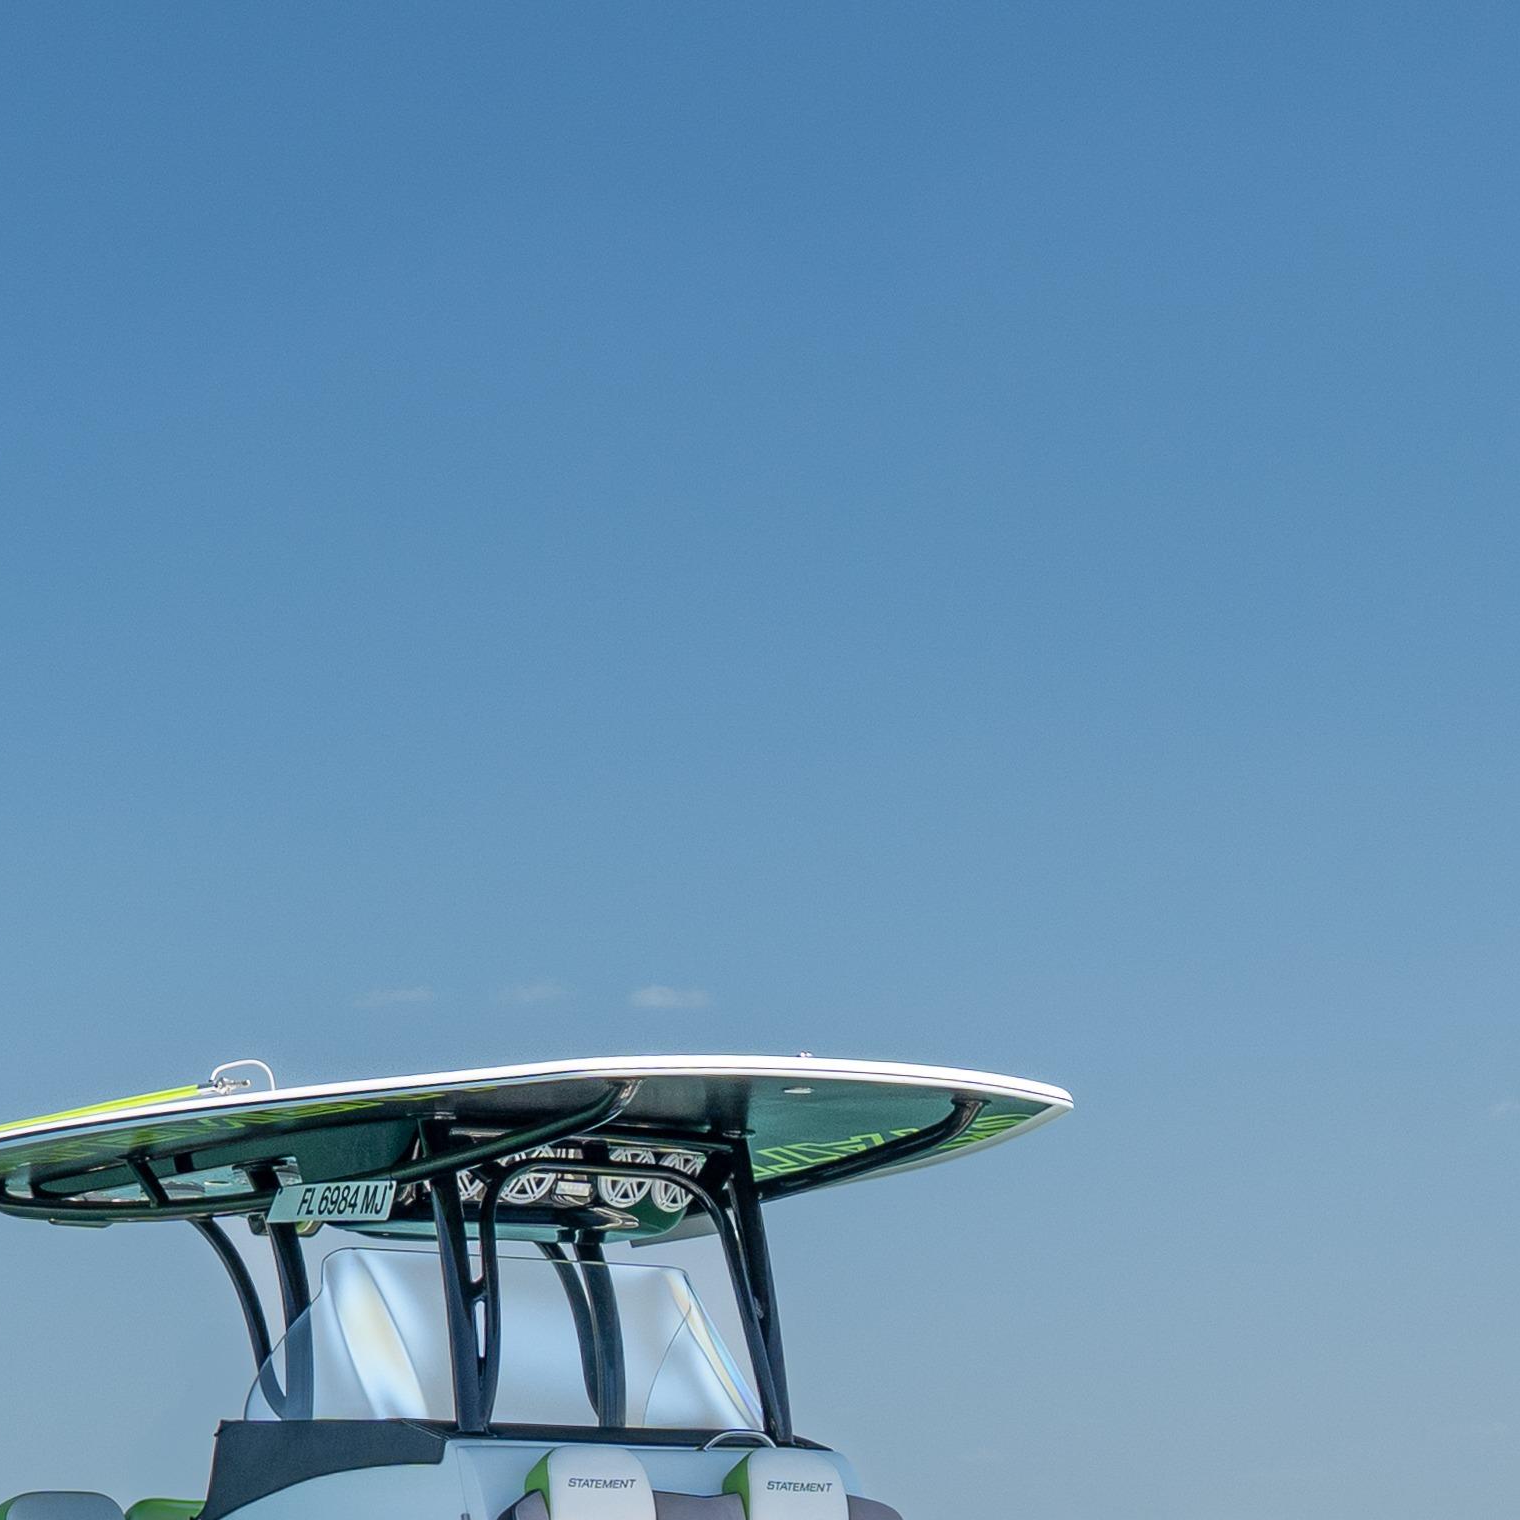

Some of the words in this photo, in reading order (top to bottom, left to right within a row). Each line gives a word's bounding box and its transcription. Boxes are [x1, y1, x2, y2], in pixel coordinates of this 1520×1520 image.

[296, 1187, 316, 1216] FL
[318, 1184, 360, 1216] 6984
[360, 1184, 389, 1215] MJ
[568, 1477, 636, 1489] STATEMENT
[766, 1480, 832, 1493] STATEMENT
